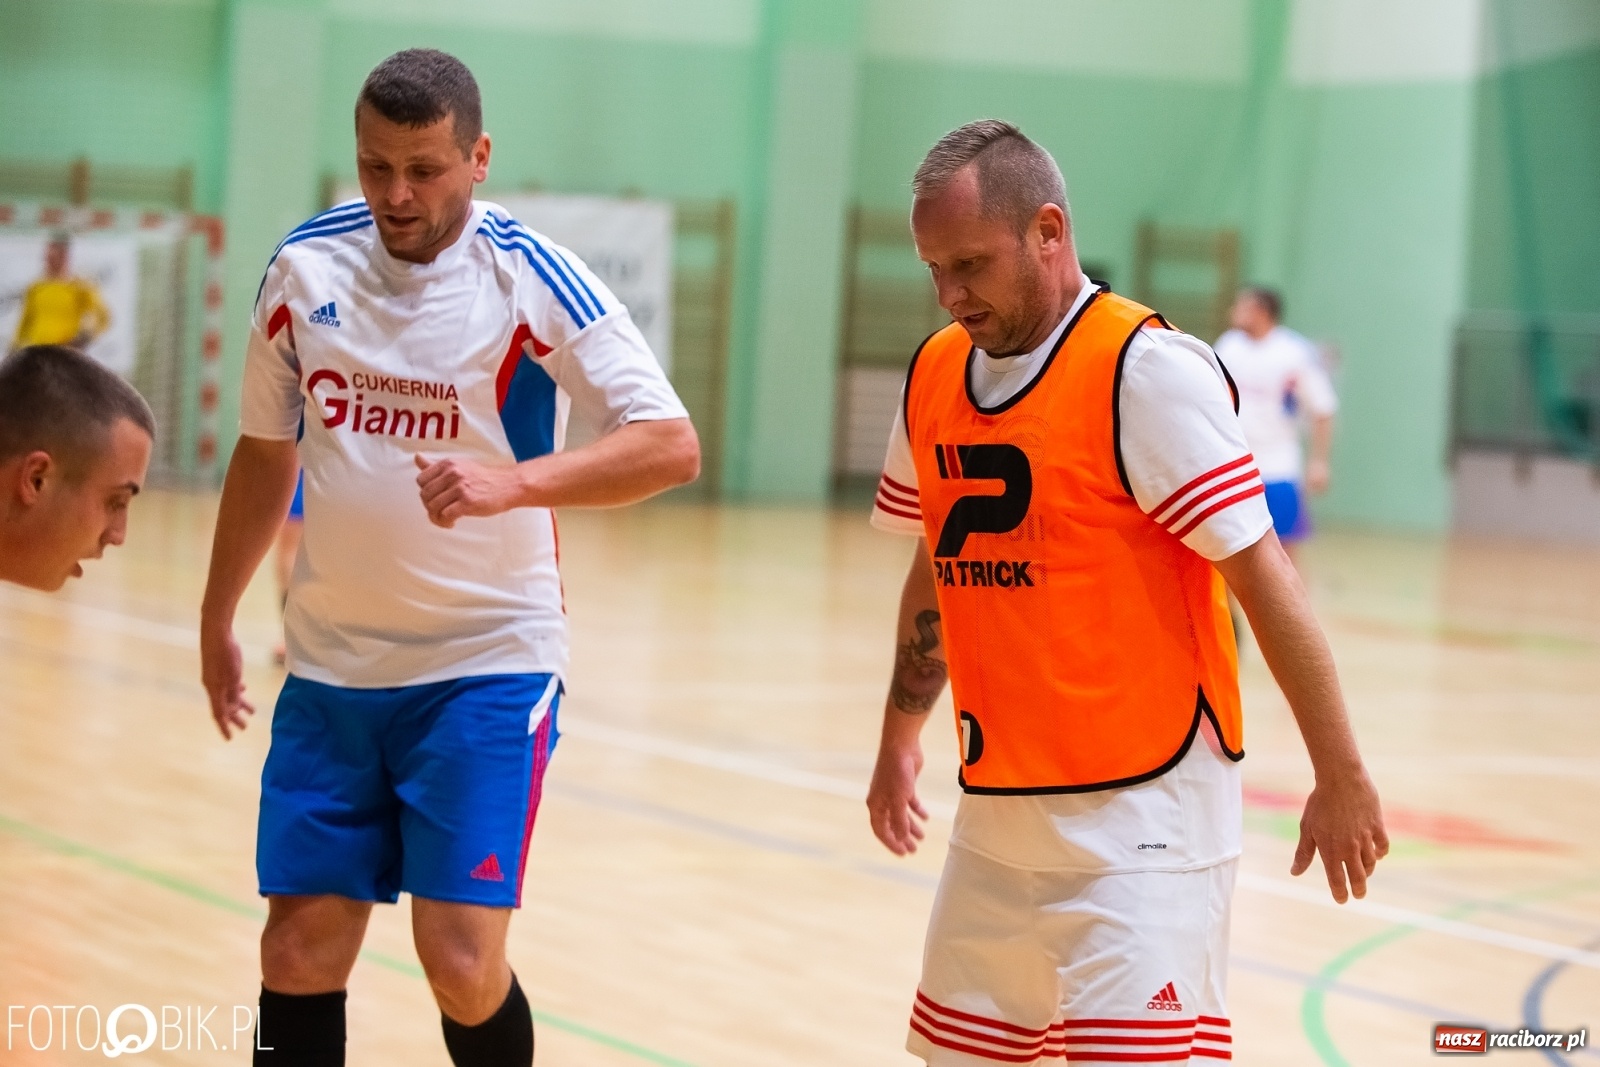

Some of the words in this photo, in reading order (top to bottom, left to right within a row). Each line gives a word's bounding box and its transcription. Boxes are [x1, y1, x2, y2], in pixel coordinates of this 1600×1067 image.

[309, 313, 341, 328] adidas
[352, 372, 459, 401] CUKIERNIA
[306, 369, 460, 440] Gianni
[1146, 1000, 1183, 1012] adidas
